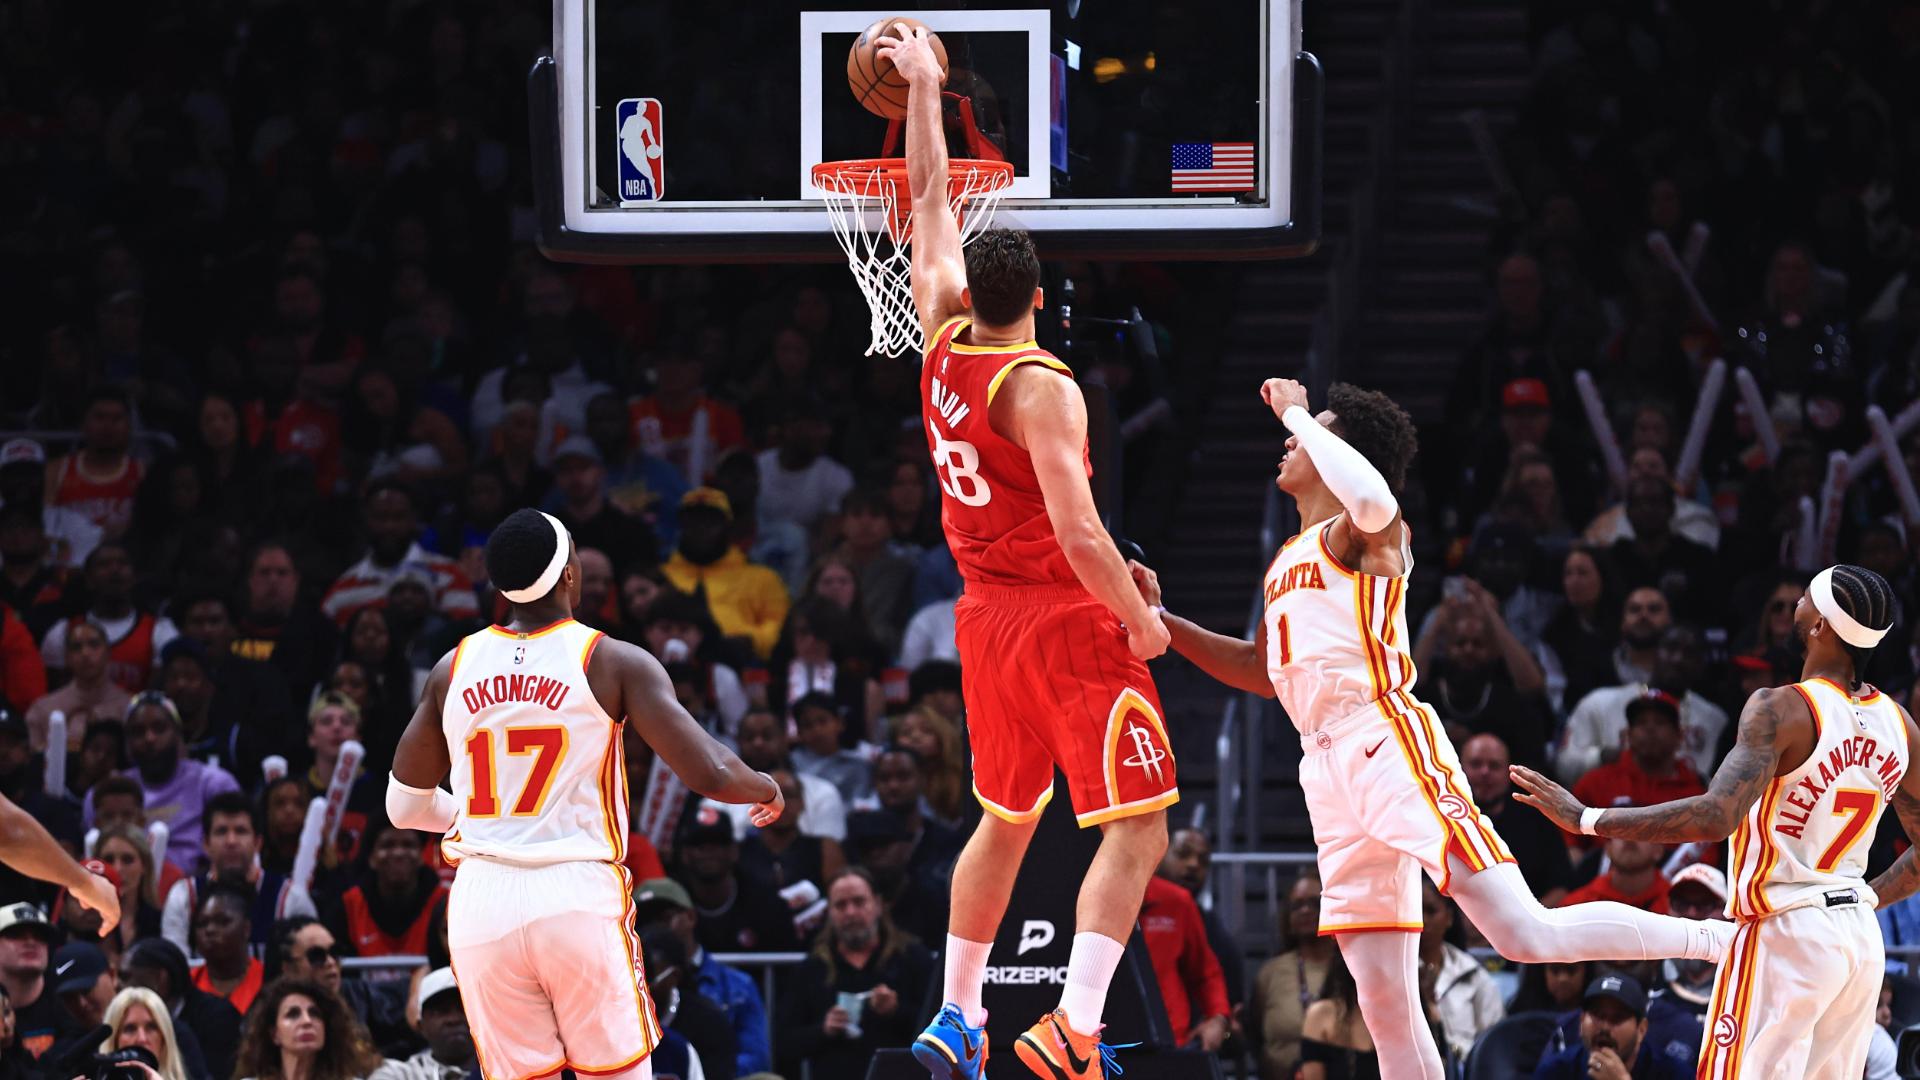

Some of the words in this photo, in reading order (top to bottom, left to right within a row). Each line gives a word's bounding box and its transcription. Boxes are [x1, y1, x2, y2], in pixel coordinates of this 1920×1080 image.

[625, 179, 648, 196] NBA
[1264, 561, 1328, 614] TLANTA
[1277, 612, 1293, 668] 1
[461, 673, 571, 716] OKONGWU
[464, 723, 571, 819] 17
[1814, 787, 1880, 874] 7
[983, 966, 1069, 985] RIZEPIC
